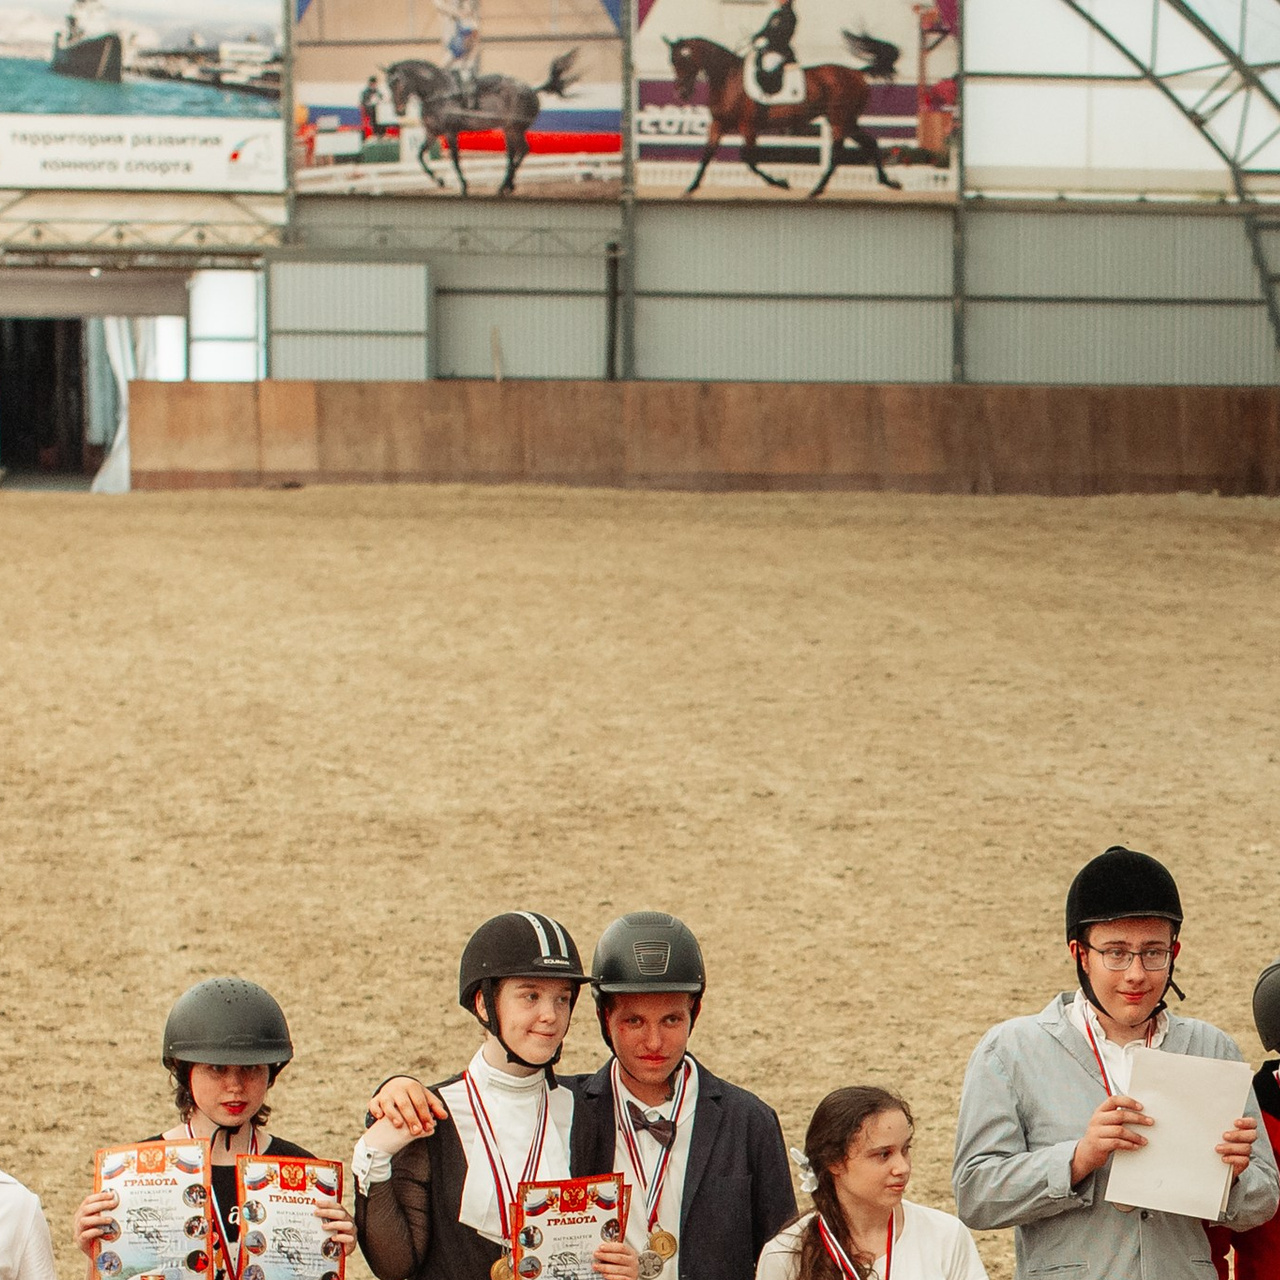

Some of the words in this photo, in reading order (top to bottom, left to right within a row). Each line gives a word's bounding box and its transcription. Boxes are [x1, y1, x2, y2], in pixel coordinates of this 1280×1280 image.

[123, 1178, 178, 1187] ГРАМОТА
[269, 1195, 317, 1205] ГРАМОТА
[547, 1215, 597, 1226] ГРАМОТА
